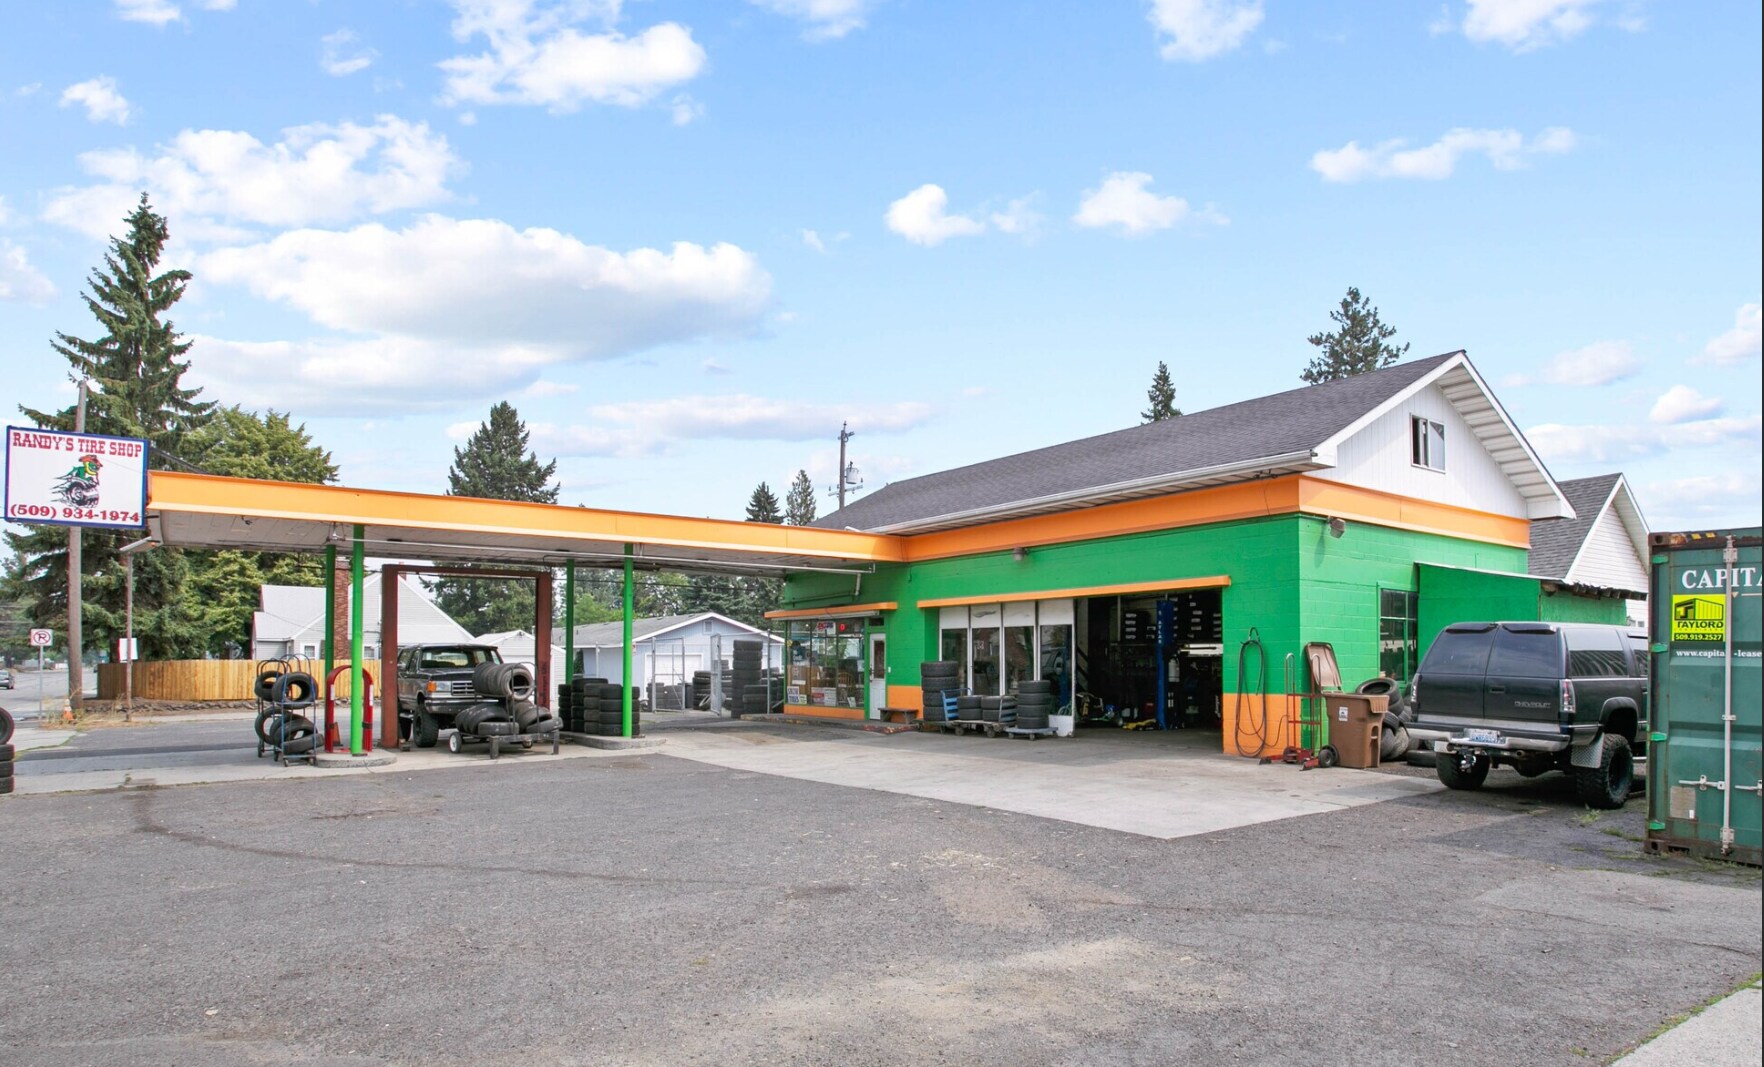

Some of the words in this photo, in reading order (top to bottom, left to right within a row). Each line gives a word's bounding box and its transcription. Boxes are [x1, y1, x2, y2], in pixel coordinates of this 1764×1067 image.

[13, 432, 74, 451] RANDY'S
[78, 438, 106, 455] TIRE
[109, 442, 142, 457] SHOP
[10, 504, 57, 519] (509)
[62, 508, 140, 522] 934-1974
